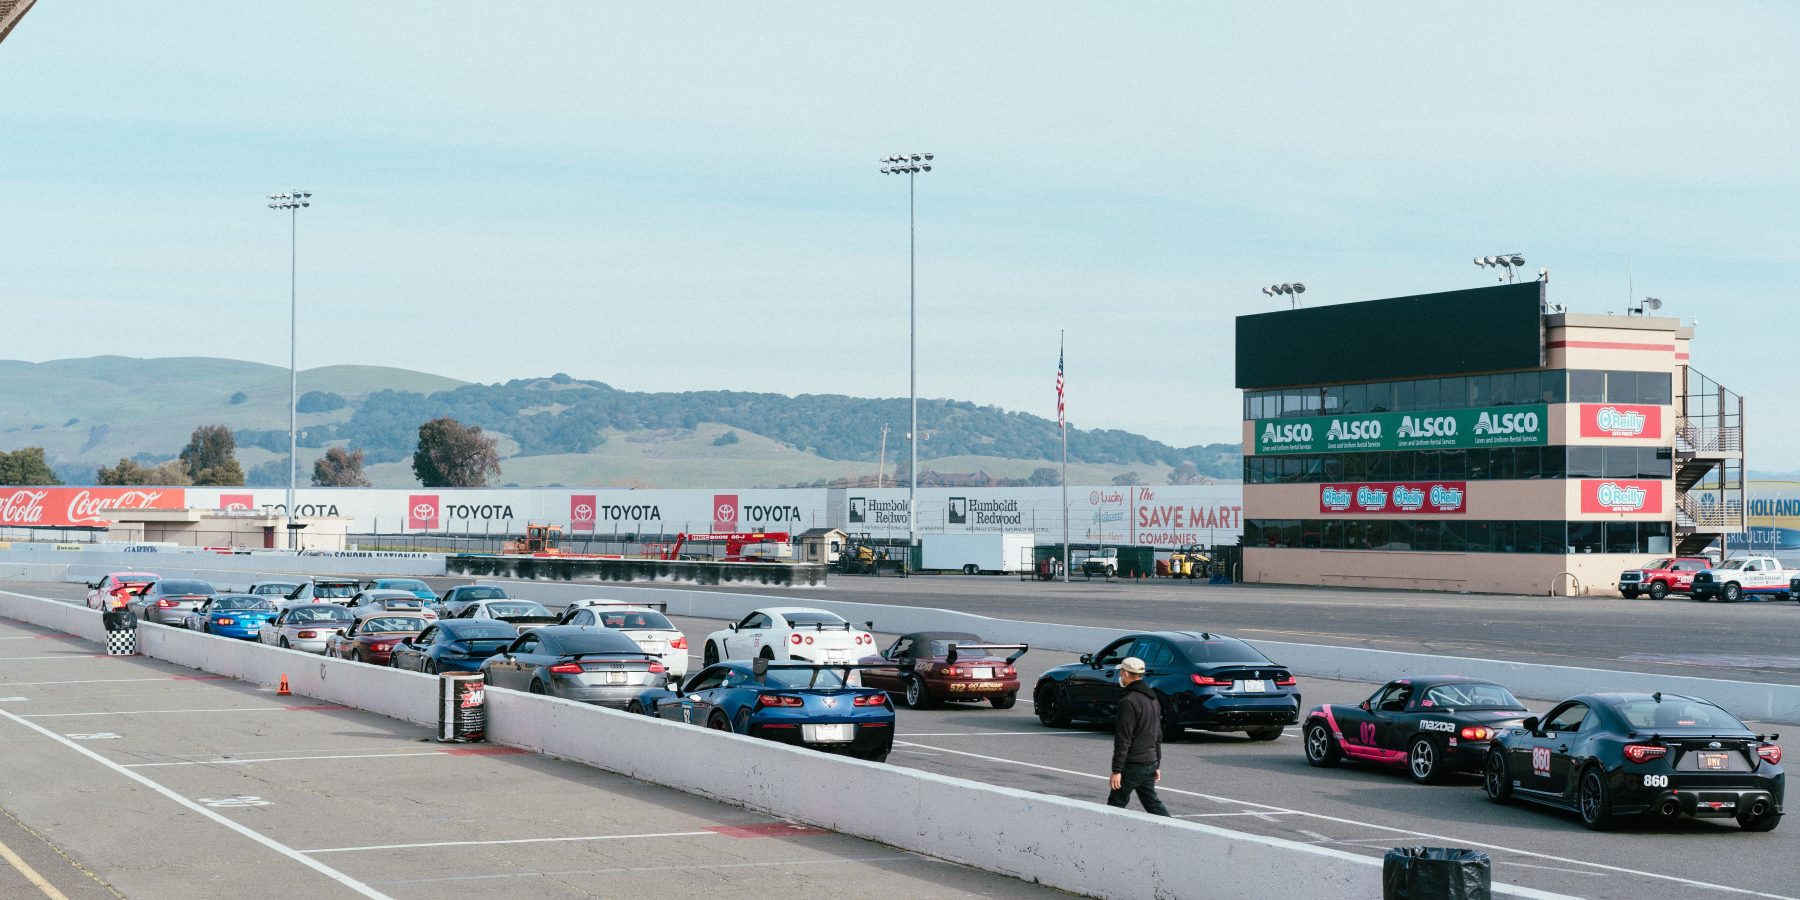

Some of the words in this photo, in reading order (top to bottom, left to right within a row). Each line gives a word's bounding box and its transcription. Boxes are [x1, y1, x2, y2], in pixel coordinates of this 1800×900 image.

[1326, 419, 1382, 440] ALSCO
[1396, 415, 1458, 437] ALSCO
[1473, 411, 1540, 434] ALSCO
[1598, 408, 1645, 433] O'Reilly
[1261, 423, 1313, 443] ALSCO
[1100, 491, 1124, 506] Lucky
[1139, 487, 1155, 501] The
[1323, 488, 1352, 507] O'Reilly
[1358, 487, 1387, 507] O'Reilly
[1394, 486, 1425, 507] O'Reilly
[1431, 486, 1463, 507] O'Reilly
[1598, 483, 1646, 508] O'Reilly
[446, 505, 514, 520] TOYOTA
[602, 505, 661, 521] TOYOTA
[744, 505, 801, 522] TOYOTA
[969, 500, 1017, 512] Humboldt
[977, 512, 1021, 524] Redwood
[1139, 505, 1184, 528] SAVE
[1189, 506, 1241, 529] MART
[1139, 532, 1197, 545] COMPANIES
[280, 682, 289, 691] 21
[1360, 721, 1377, 746] 02
[1533, 747, 1550, 771] 860
[1643, 774, 1669, 788] 860
